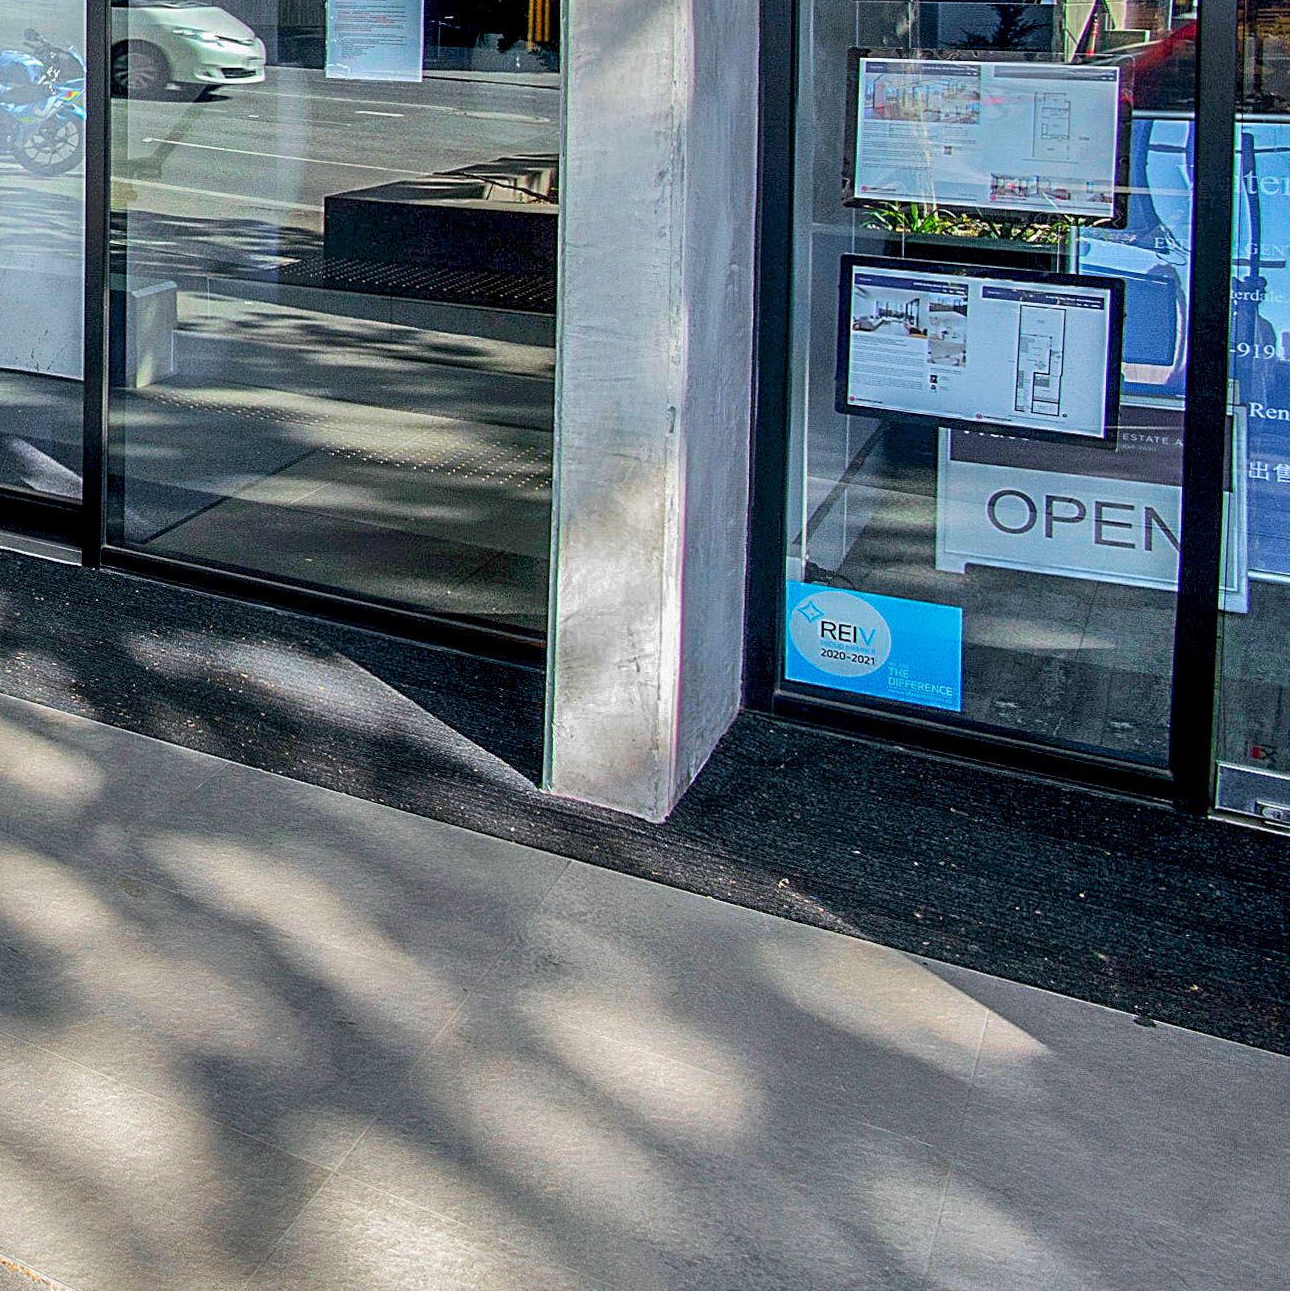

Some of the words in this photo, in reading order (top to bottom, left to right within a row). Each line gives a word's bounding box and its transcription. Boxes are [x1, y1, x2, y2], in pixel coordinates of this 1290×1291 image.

[1122, 432, 1169, 445] ESTATE
[986, 489, 1181, 552] OPEN
[821, 620, 877, 647] REIV
[821, 648, 875, 665] 2020-2021
[888, 666, 909, 679] THE
[888, 676, 953, 696] DIFFERENCE
